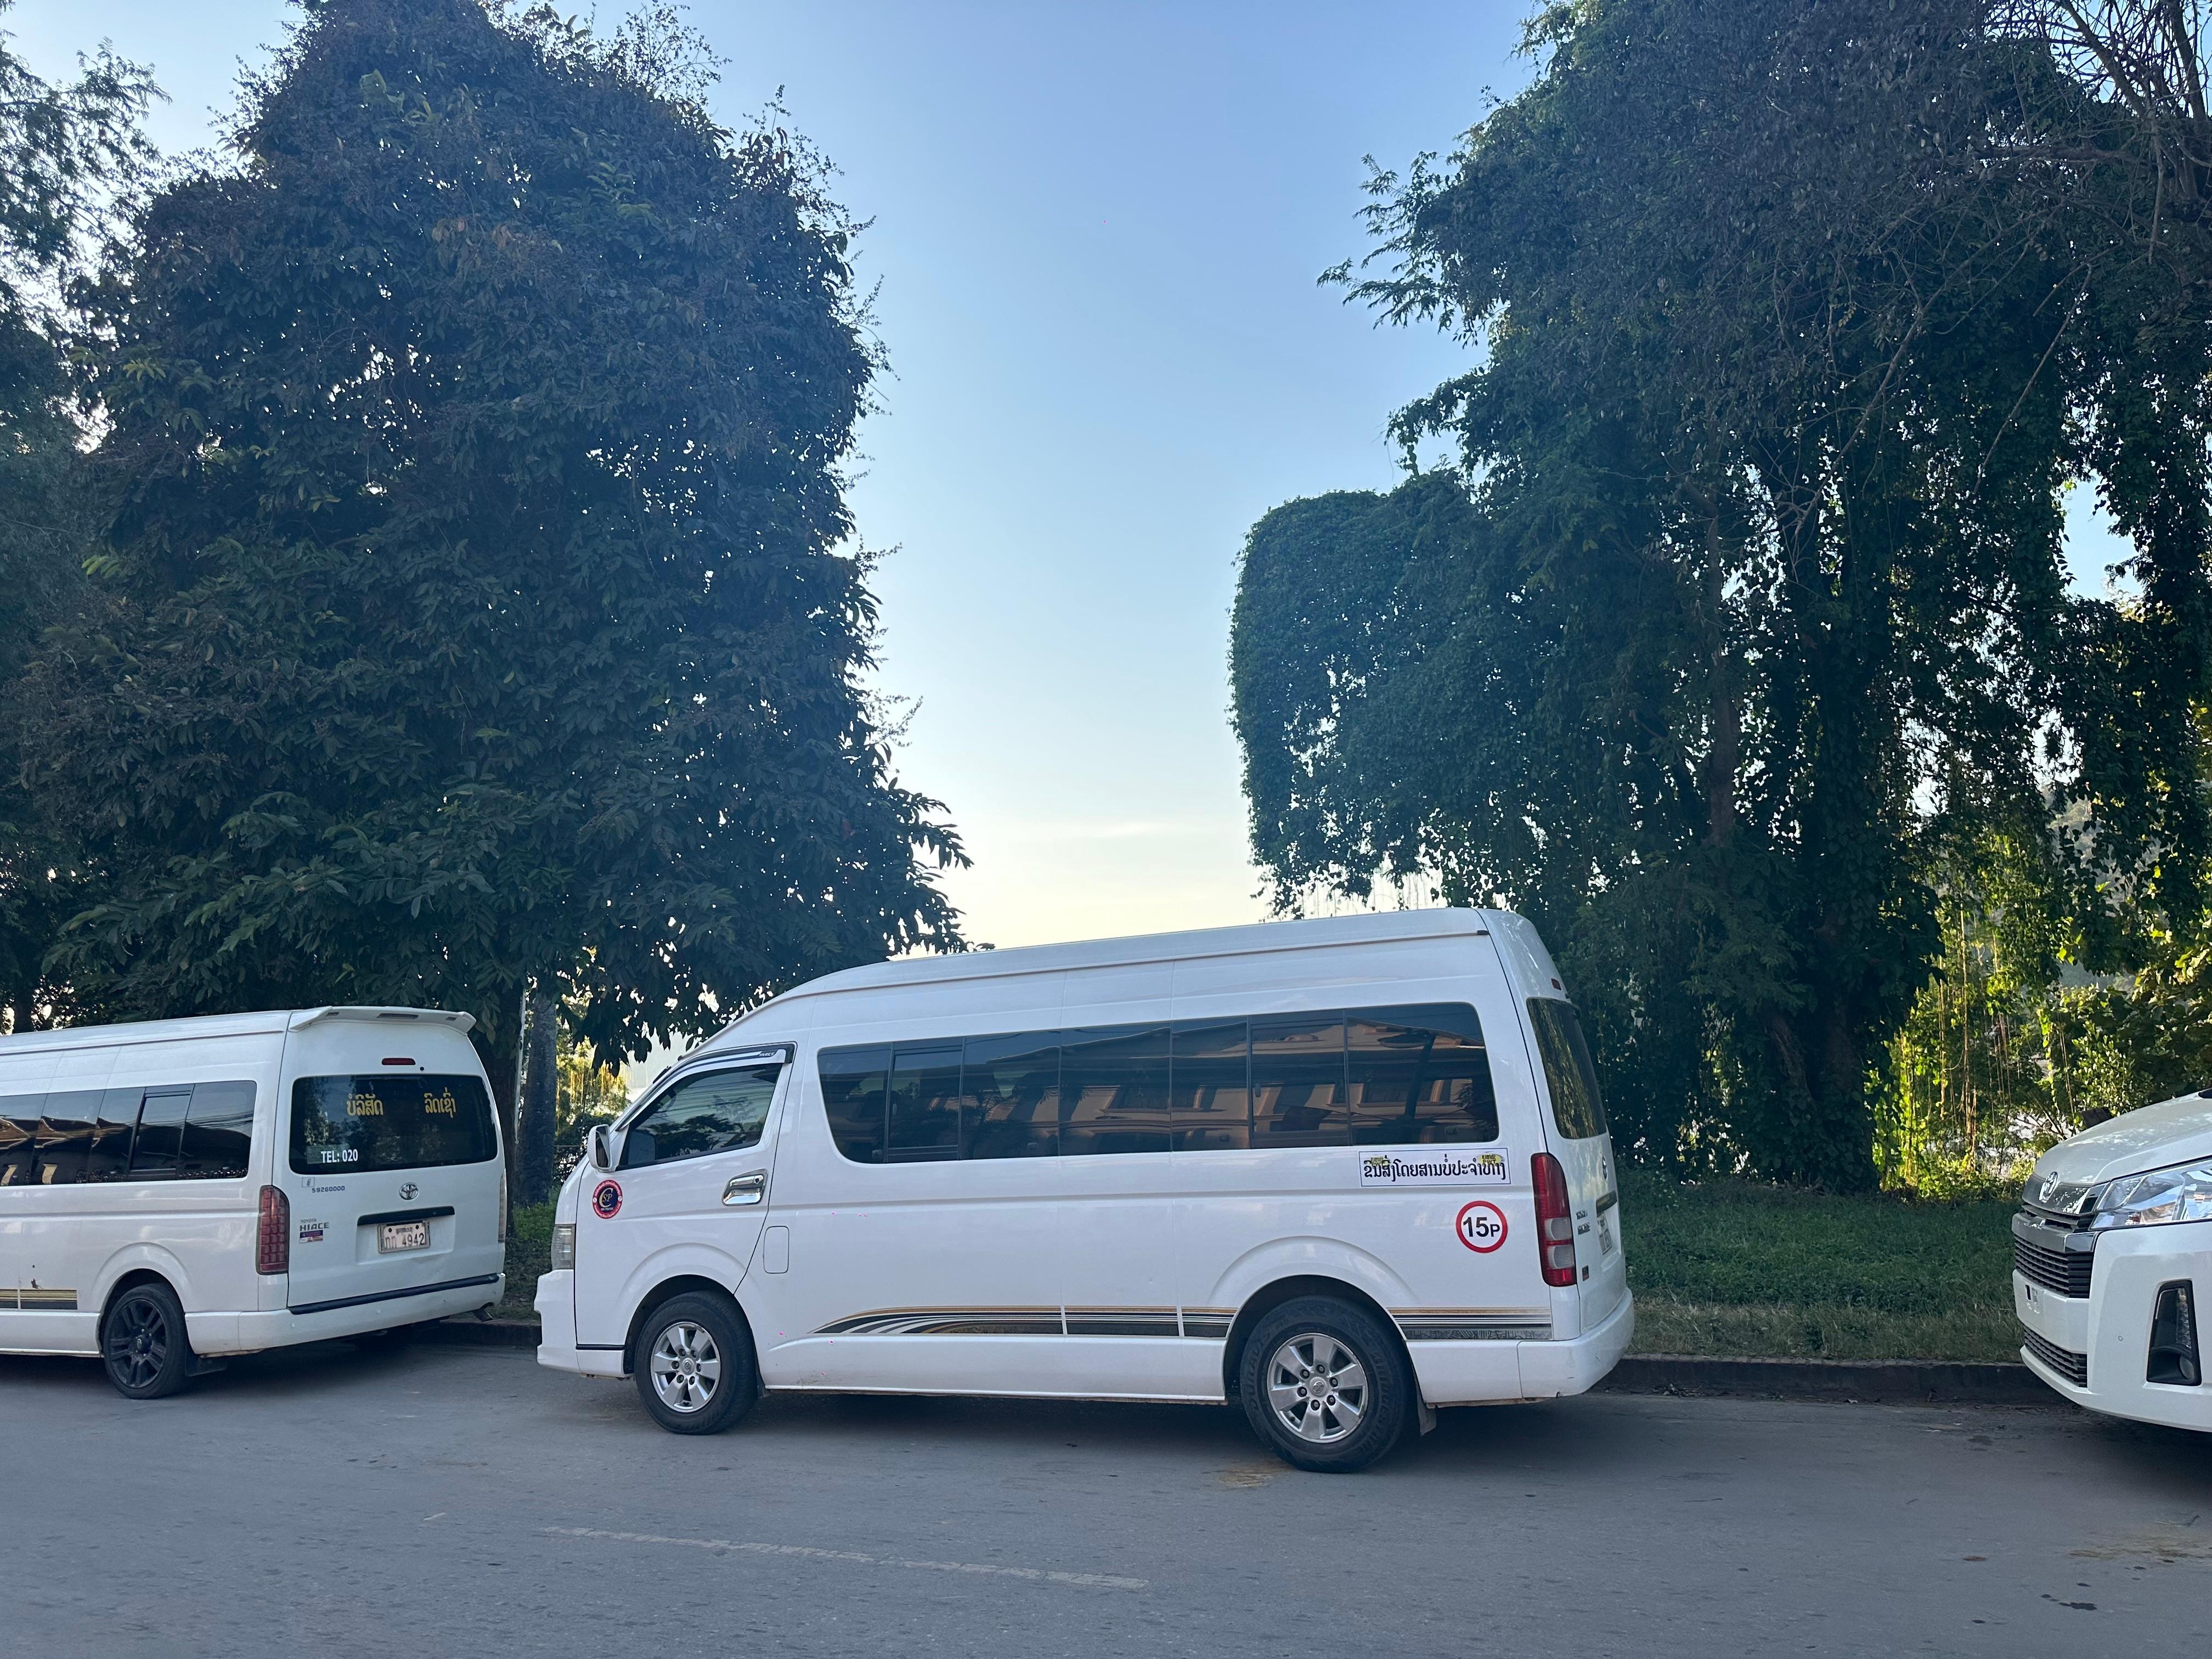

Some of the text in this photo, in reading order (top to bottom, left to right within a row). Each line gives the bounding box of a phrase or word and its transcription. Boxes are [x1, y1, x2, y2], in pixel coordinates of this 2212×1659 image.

[321, 1149, 358, 1163] TEL: 020
[300, 1222, 330, 1232] HIACE
[1463, 1216, 1500, 1237] 15P
[403, 1232, 427, 1248] 4942
